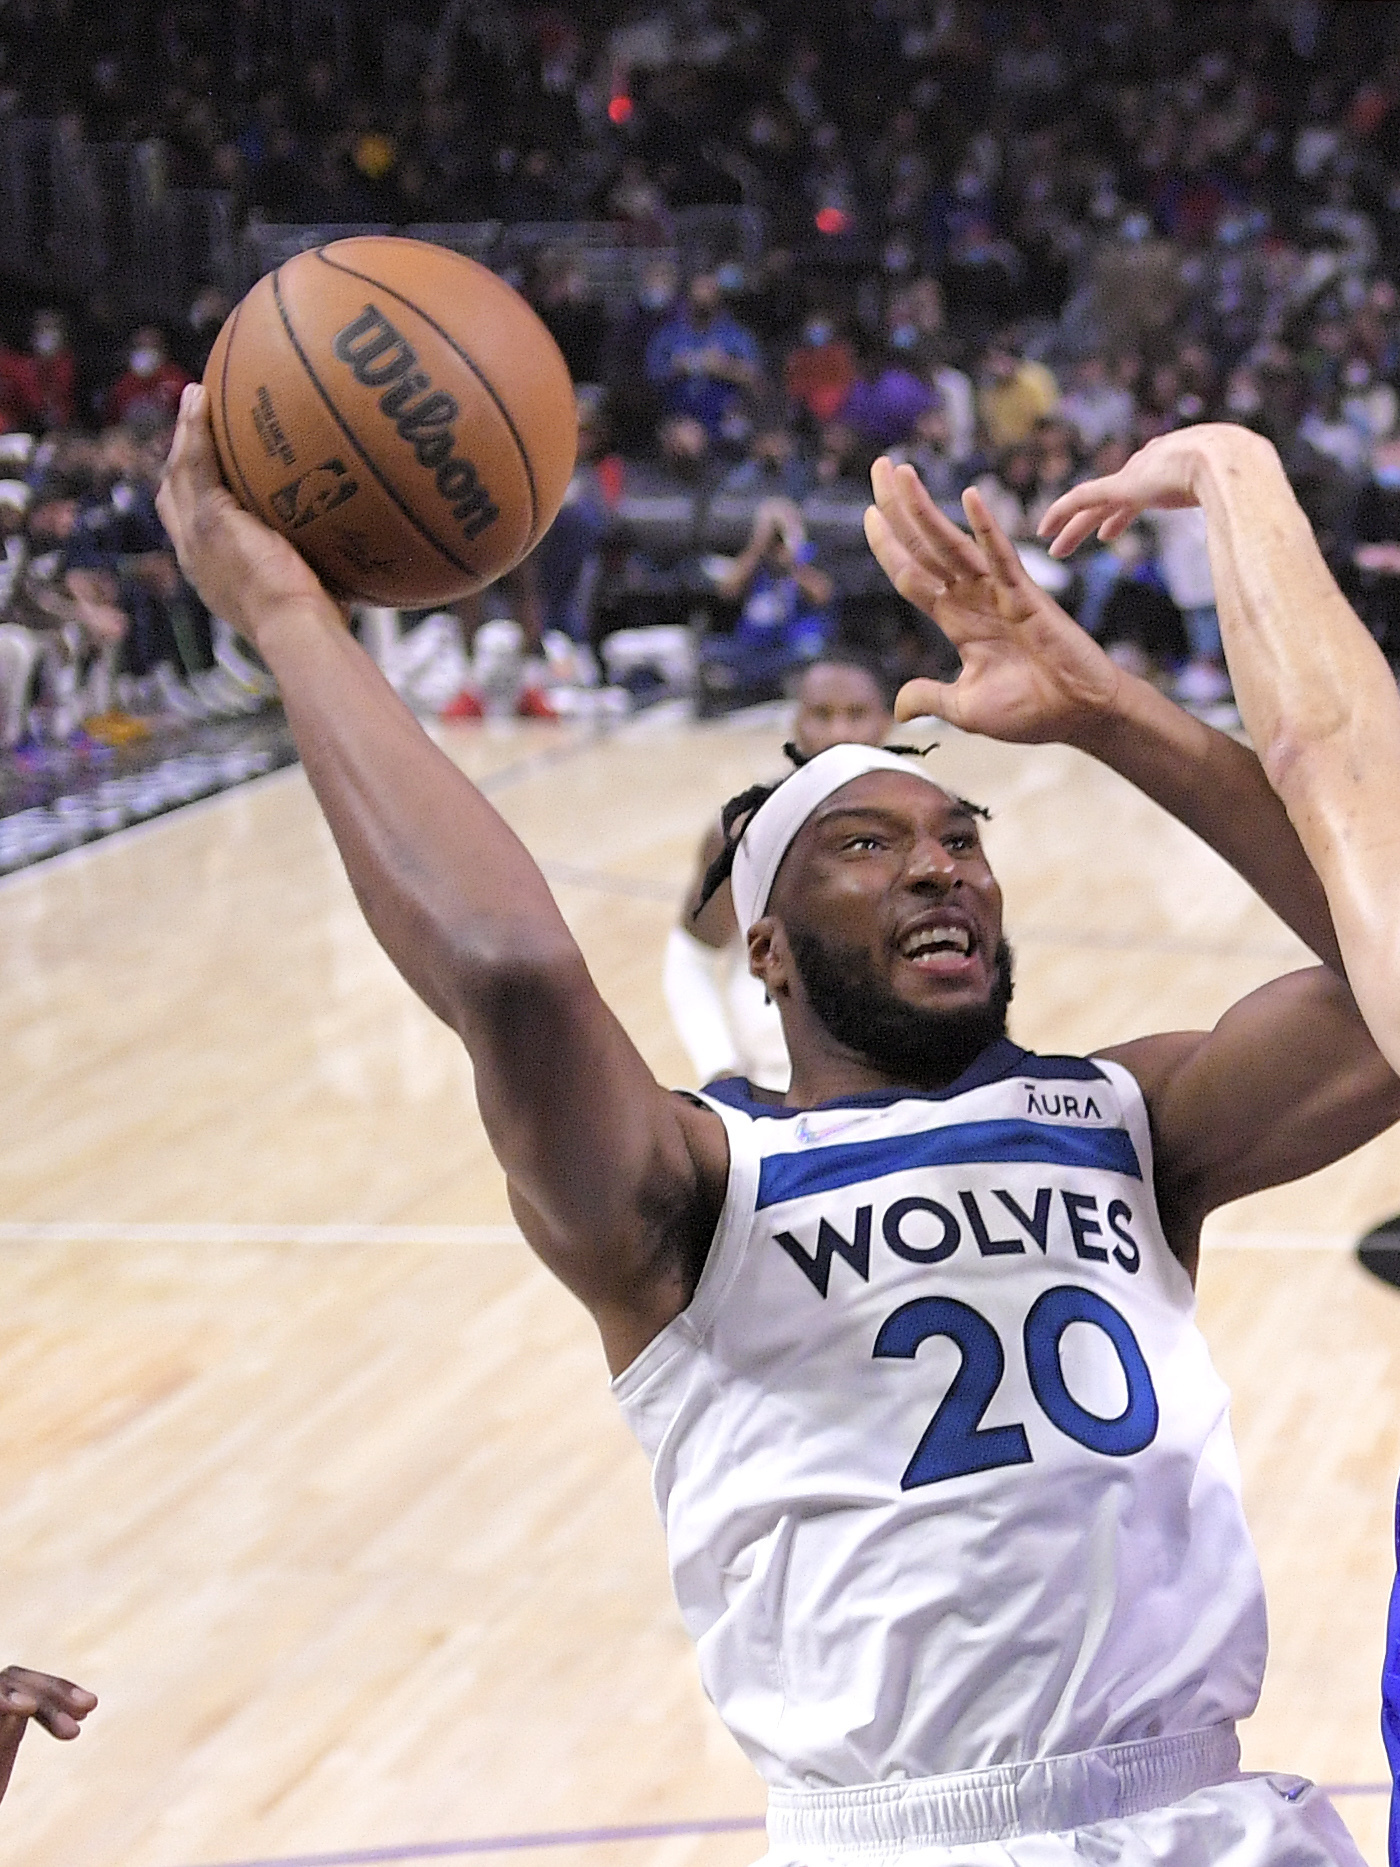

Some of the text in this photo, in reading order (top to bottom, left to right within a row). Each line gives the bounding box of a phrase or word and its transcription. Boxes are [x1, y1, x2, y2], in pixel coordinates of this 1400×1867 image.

[332, 303, 500, 541] Wilson
[771, 1186, 1141, 1300] WOLVES
[871, 1284, 1161, 1492] 20
